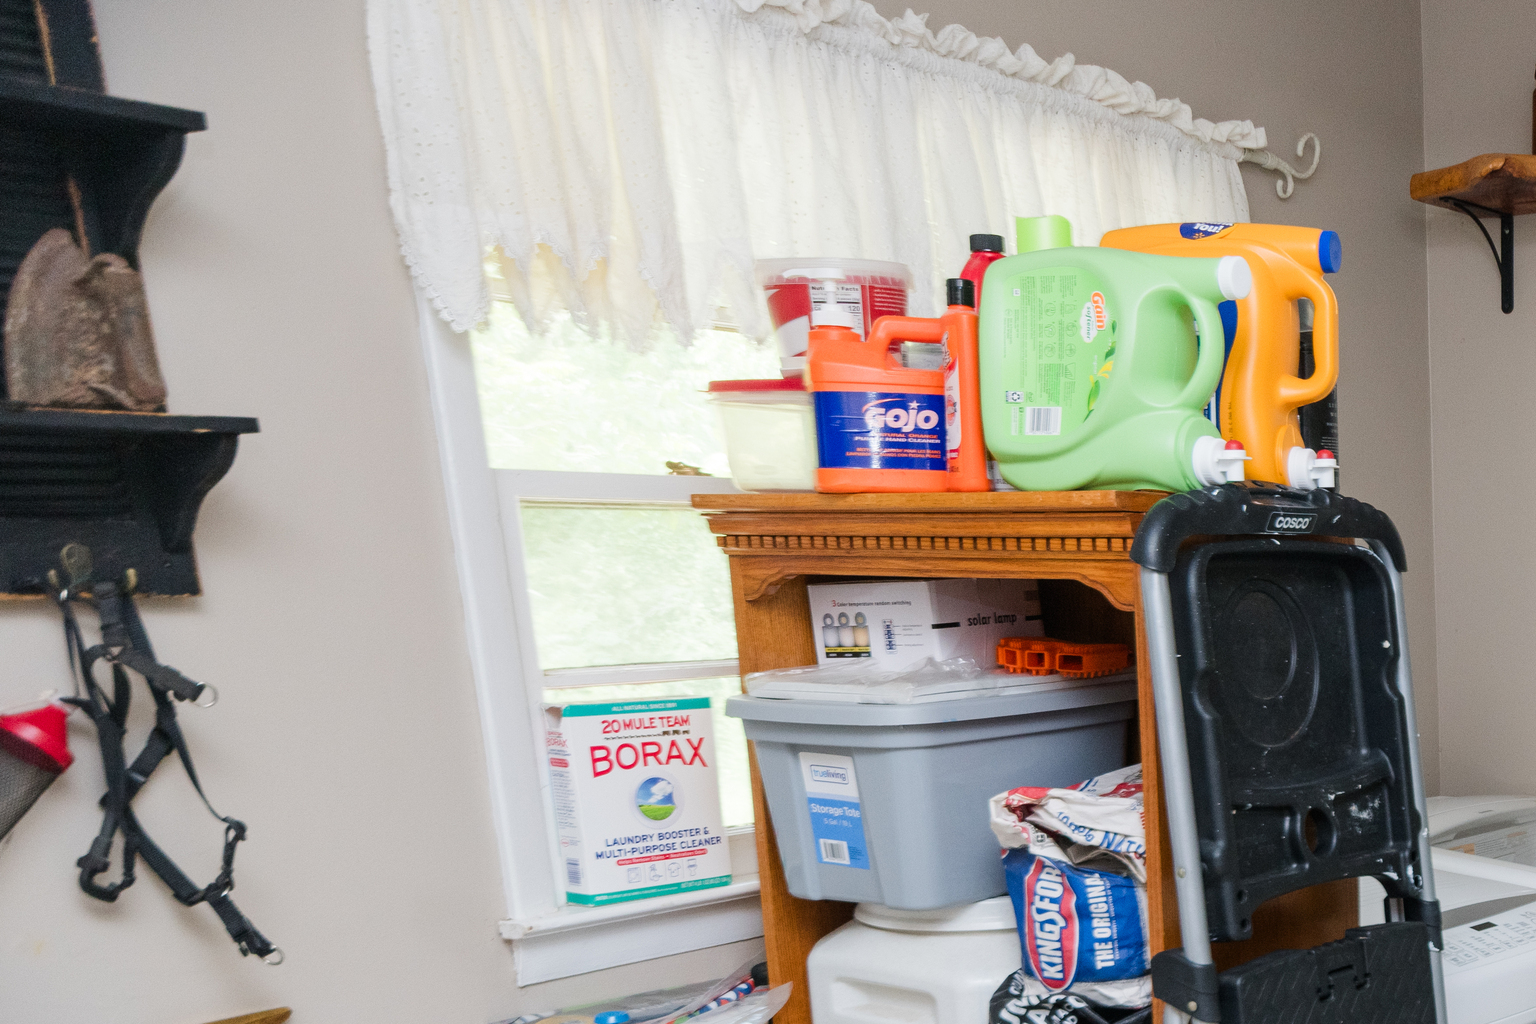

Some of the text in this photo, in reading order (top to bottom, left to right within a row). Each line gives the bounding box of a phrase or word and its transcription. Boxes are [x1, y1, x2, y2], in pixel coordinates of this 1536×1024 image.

[1091, 291, 1106, 330] Gain
[1084, 306, 1093, 341] softener
[864, 407, 939, 433] GOJO
[1275, 516, 1310, 530] COSCO
[832, 599, 837, 608] 3
[967, 611, 1017, 627] solar lamp
[601, 714, 692, 735] 20 MULE TEAM
[589, 737, 709, 779] BORAX
[812, 769, 847, 782] trueliving
[810, 803, 861, 818] Storage Tote
[595, 836, 722, 860] MULTI-PURPOSE CLEANER
[605, 826, 710, 848] LAUNDRY BOOSTER &
[1093, 941, 1115, 970] THE
